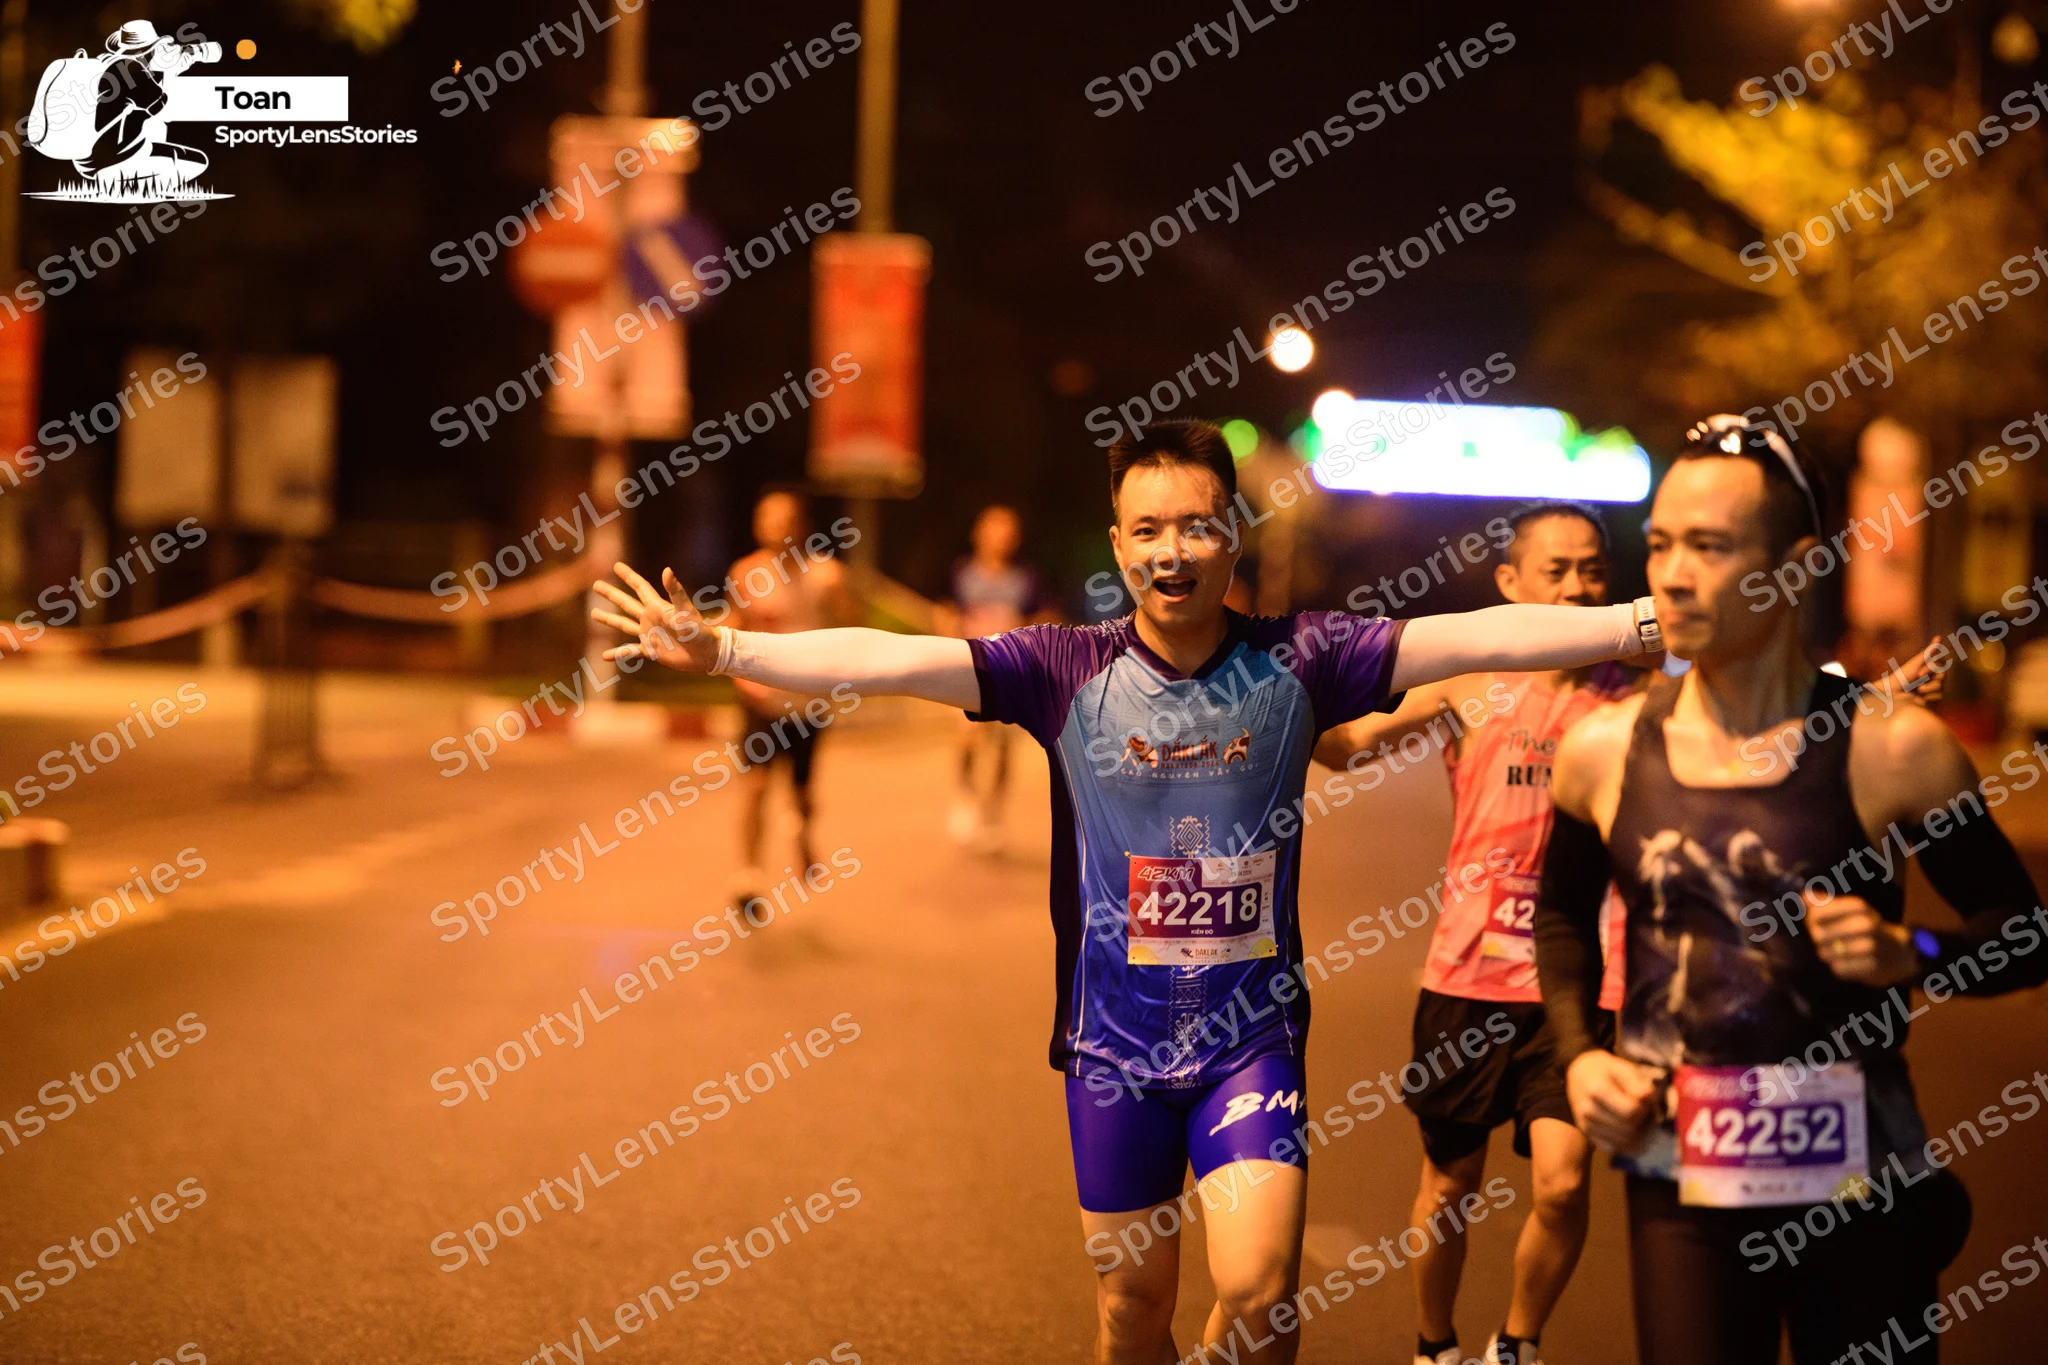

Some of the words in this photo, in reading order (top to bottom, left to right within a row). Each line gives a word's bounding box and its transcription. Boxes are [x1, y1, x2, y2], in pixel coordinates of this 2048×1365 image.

[1137, 866, 1196, 882] 42KM
[1137, 888, 1258, 926] 42218
[1685, 1106, 1842, 1157] 42252
